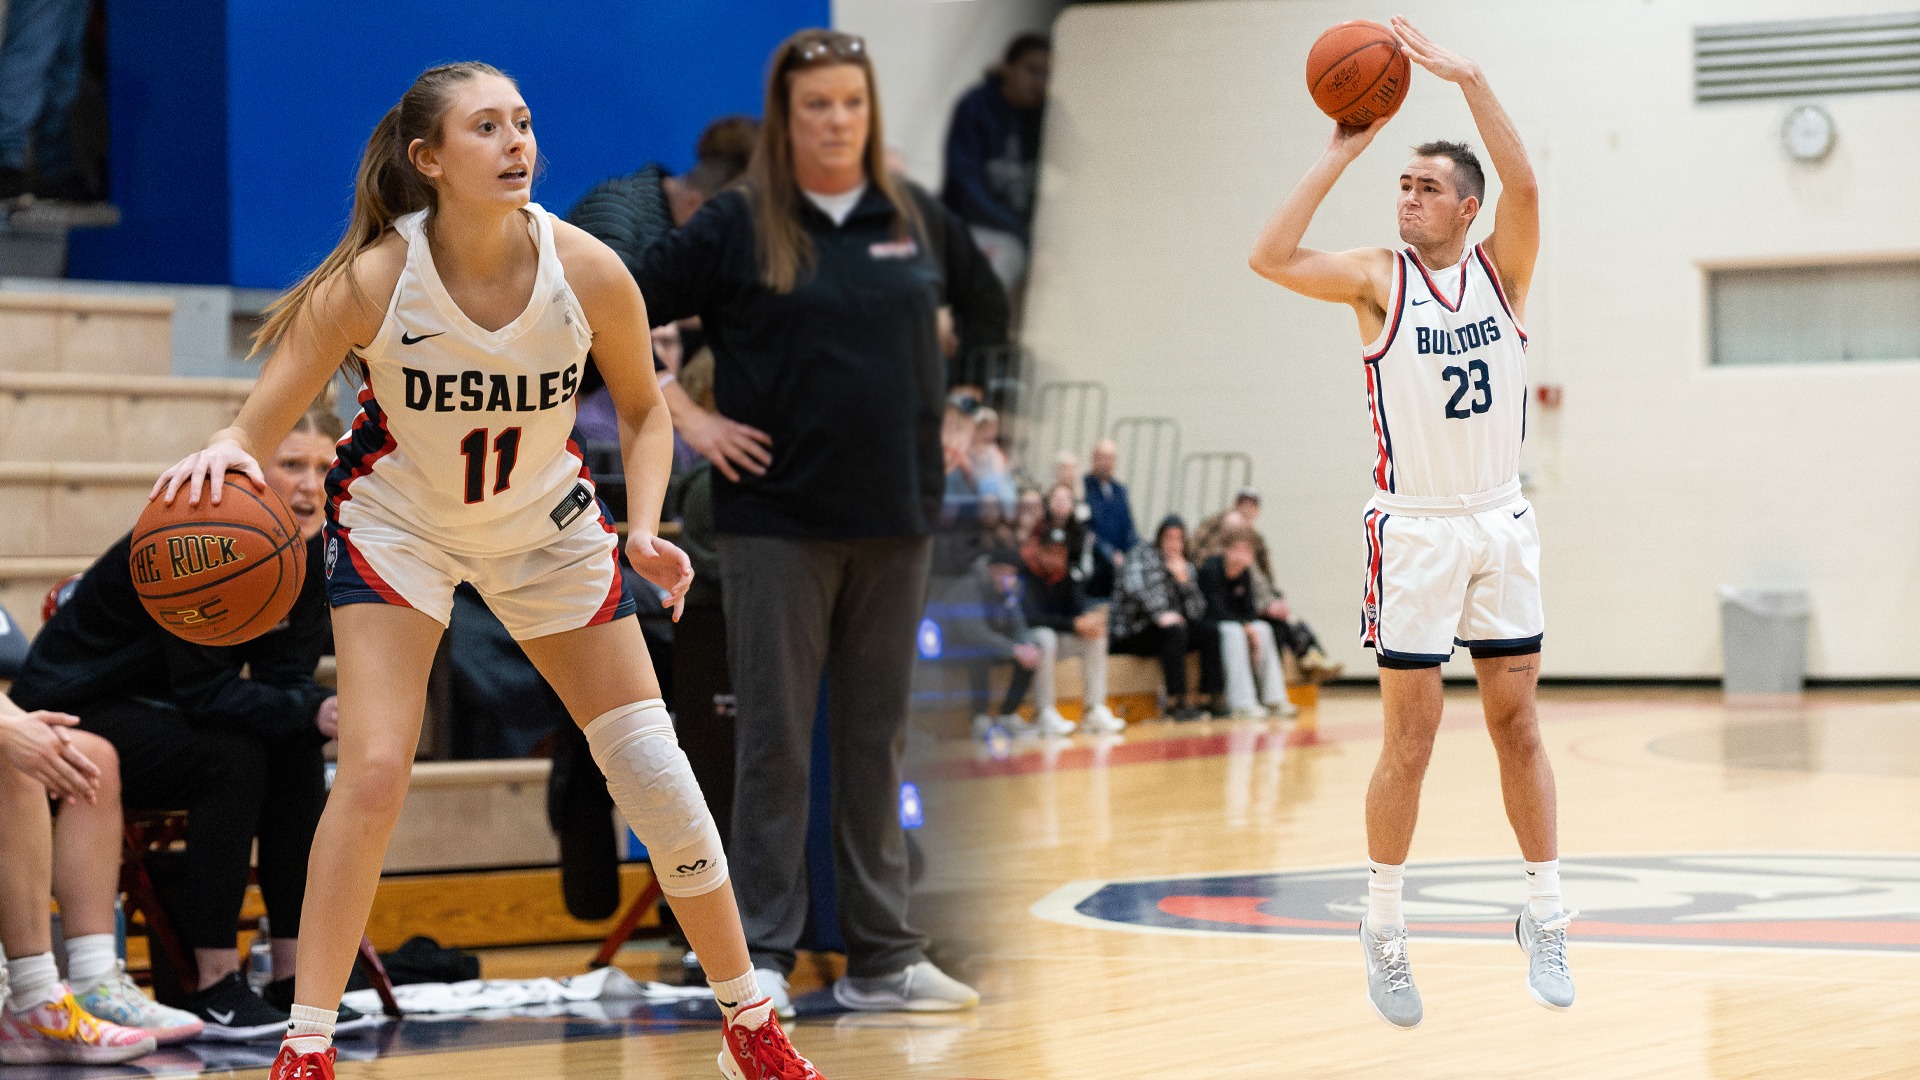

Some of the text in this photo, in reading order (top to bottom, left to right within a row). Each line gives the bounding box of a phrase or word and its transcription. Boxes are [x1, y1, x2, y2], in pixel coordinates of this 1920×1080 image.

[1415, 316, 1502, 355] BULDOGS
[402, 363, 578, 412] DESALES
[1442, 359, 1492, 419] 23
[460, 426, 522, 504] 11
[577, 491, 587, 503] M
[131, 535, 239, 584] THE ROCK
